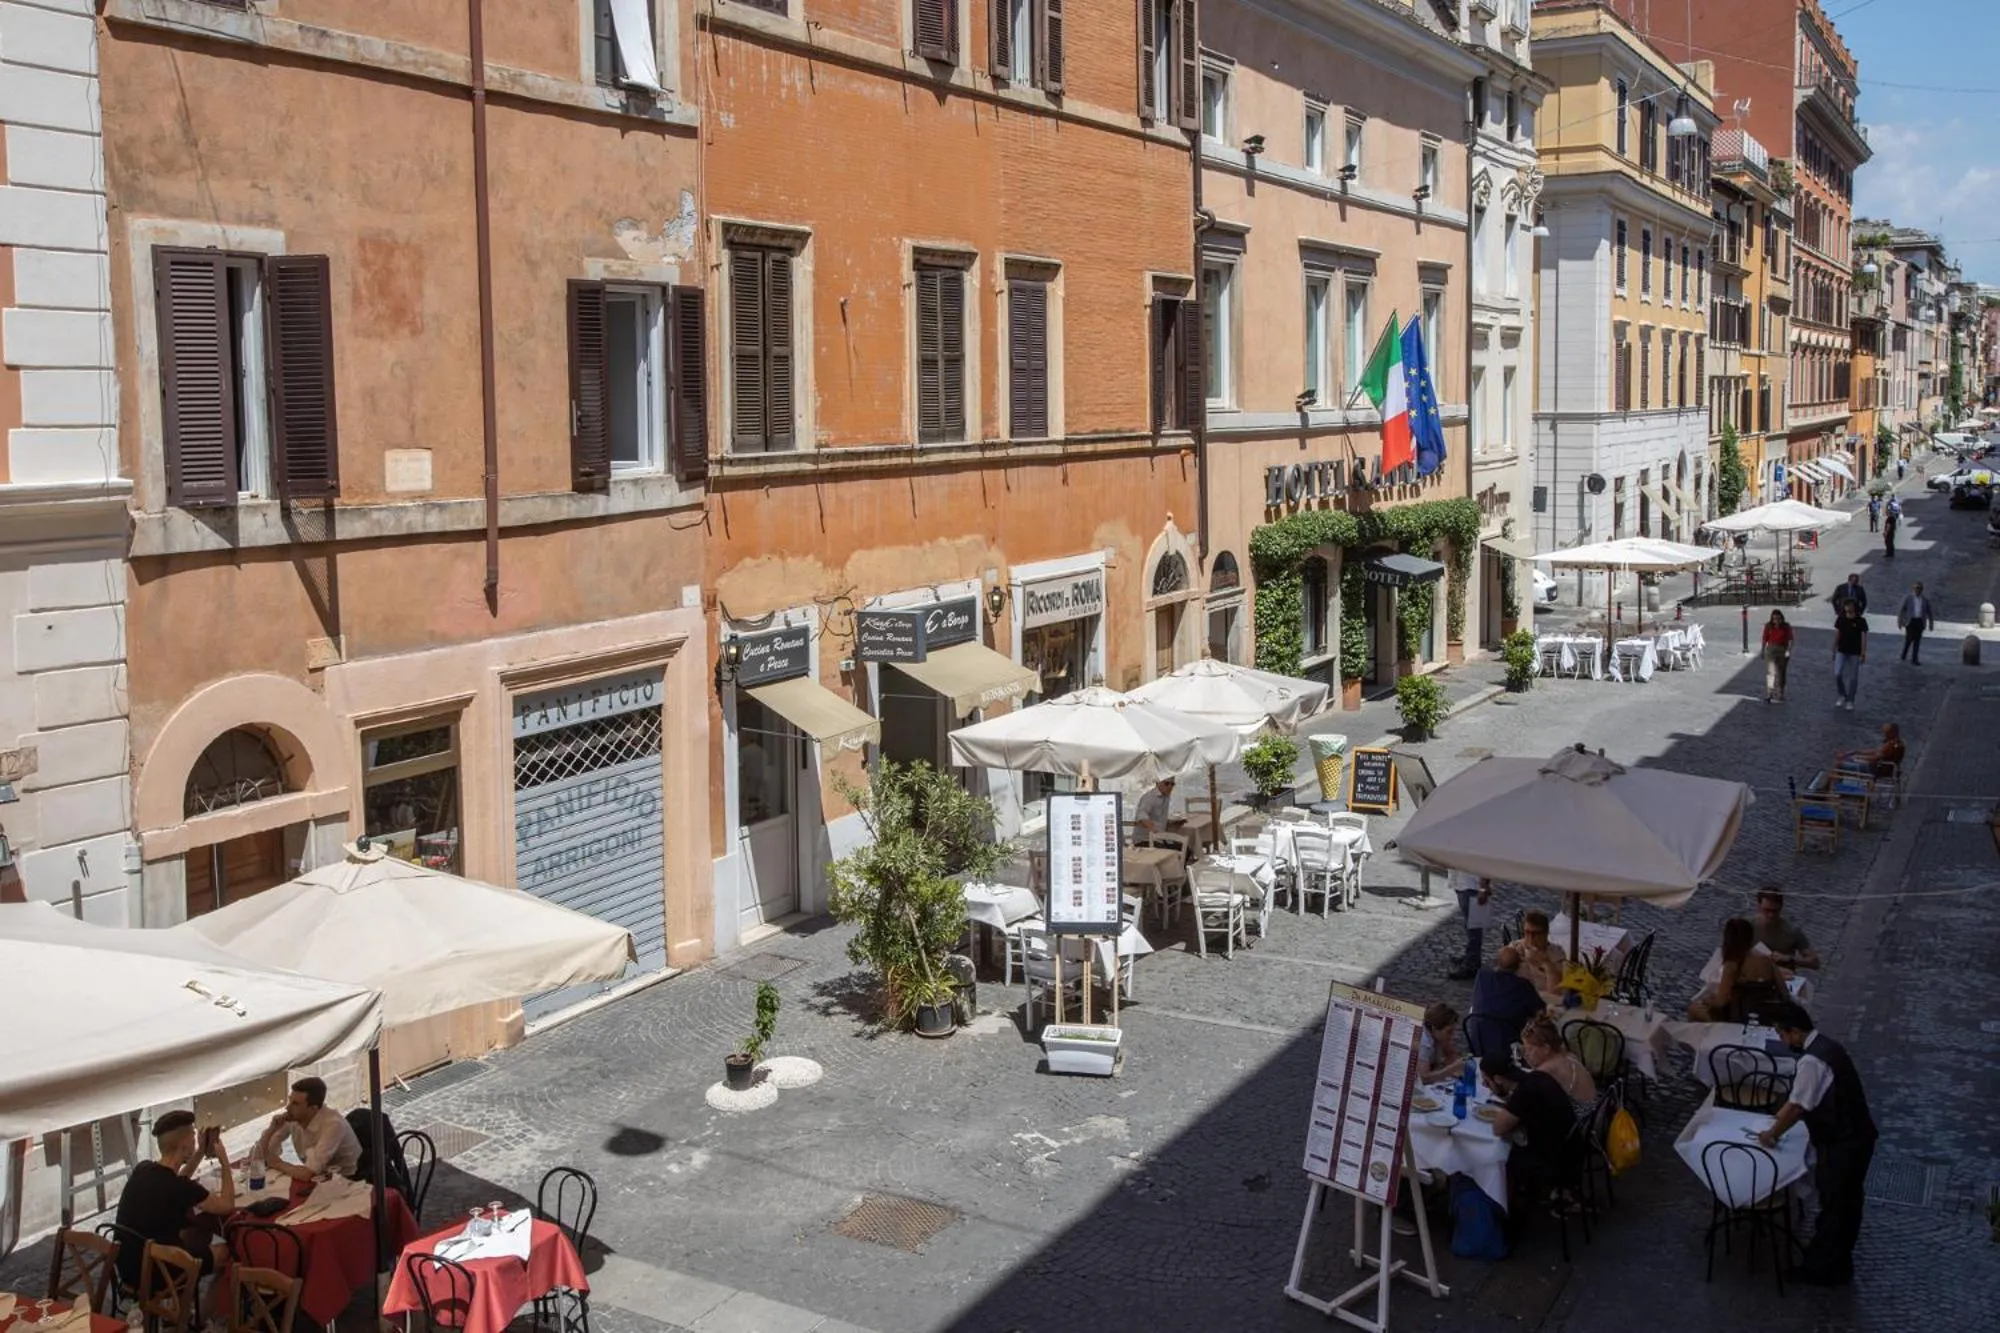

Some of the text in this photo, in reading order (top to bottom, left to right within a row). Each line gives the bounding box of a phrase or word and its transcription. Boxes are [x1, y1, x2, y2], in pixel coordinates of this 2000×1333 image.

[1265, 458, 1347, 506] HOTEL
[1026, 588, 1064, 617] RICORDI
[1072, 577, 1101, 607] ROMA
[742, 636, 804, 661] Cucina Romana
[767, 656, 789, 672] Pesce
[520, 679, 654, 730] PANIFICIO
